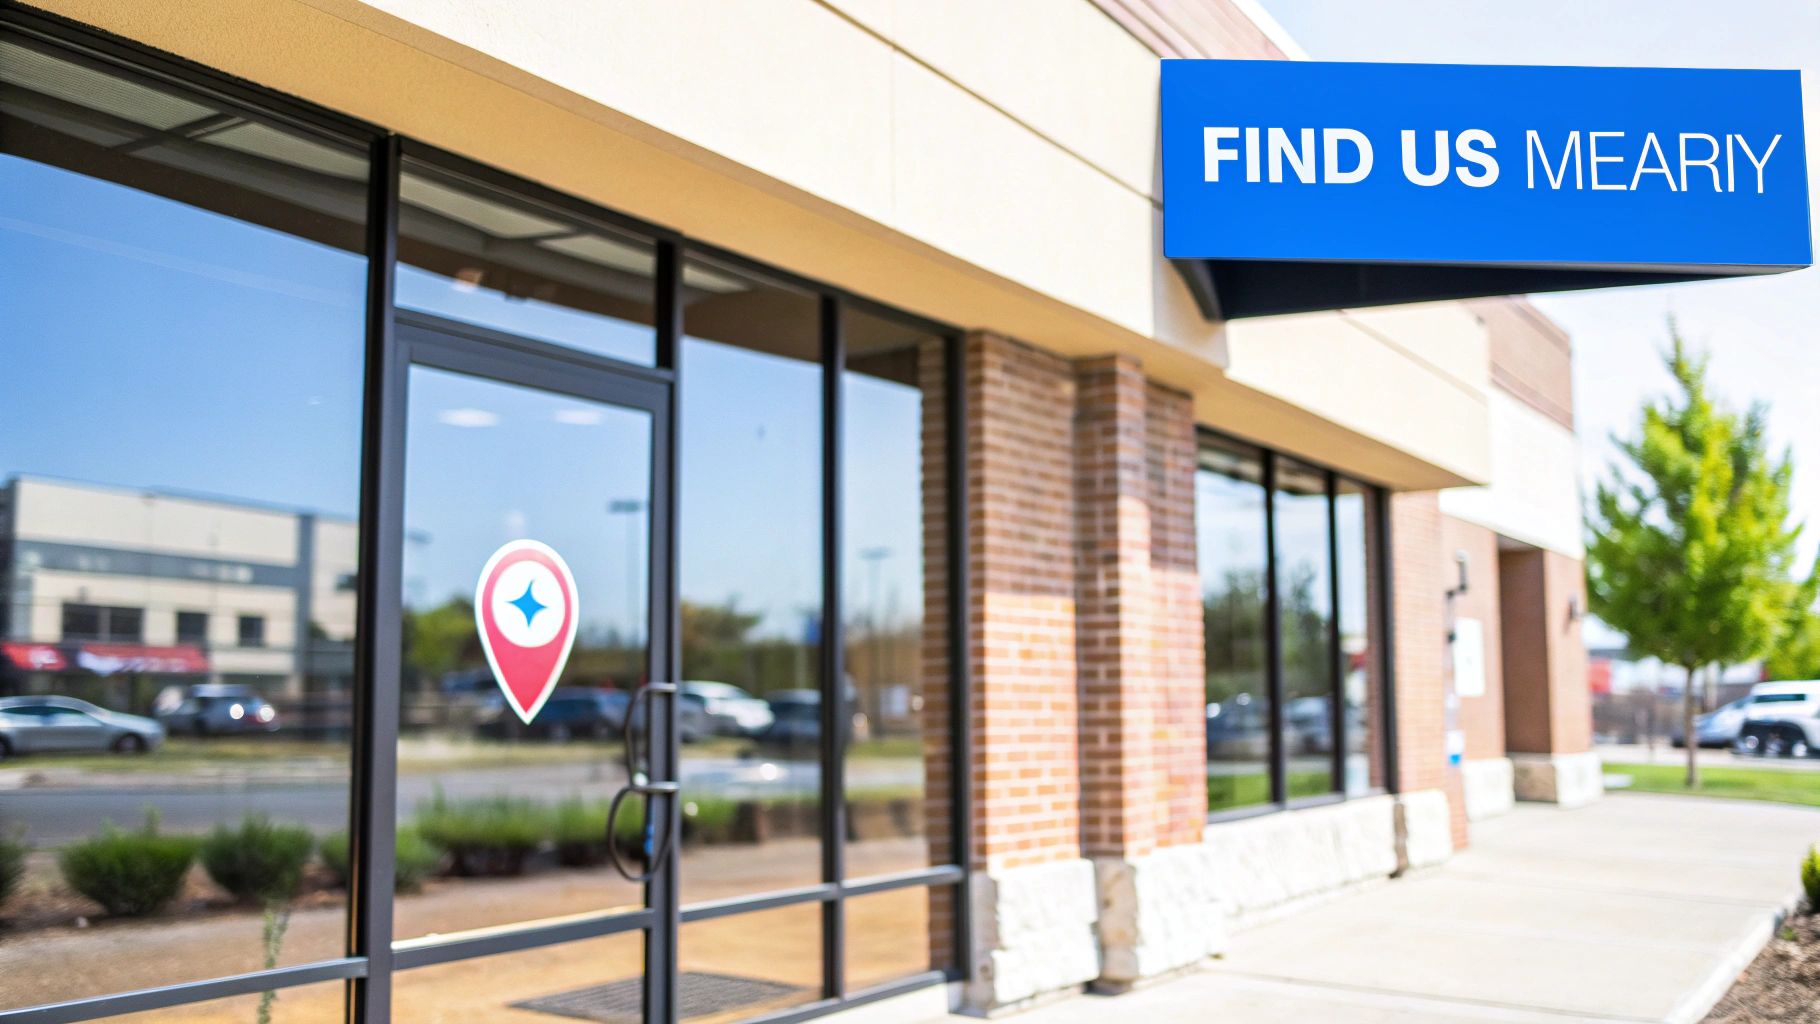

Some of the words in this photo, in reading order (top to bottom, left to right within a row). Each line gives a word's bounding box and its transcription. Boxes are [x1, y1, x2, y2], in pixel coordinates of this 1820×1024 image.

[1203, 126, 1374, 184] FIND
[1401, 129, 1500, 188] US
[1526, 129, 1783, 194] MEARIY
